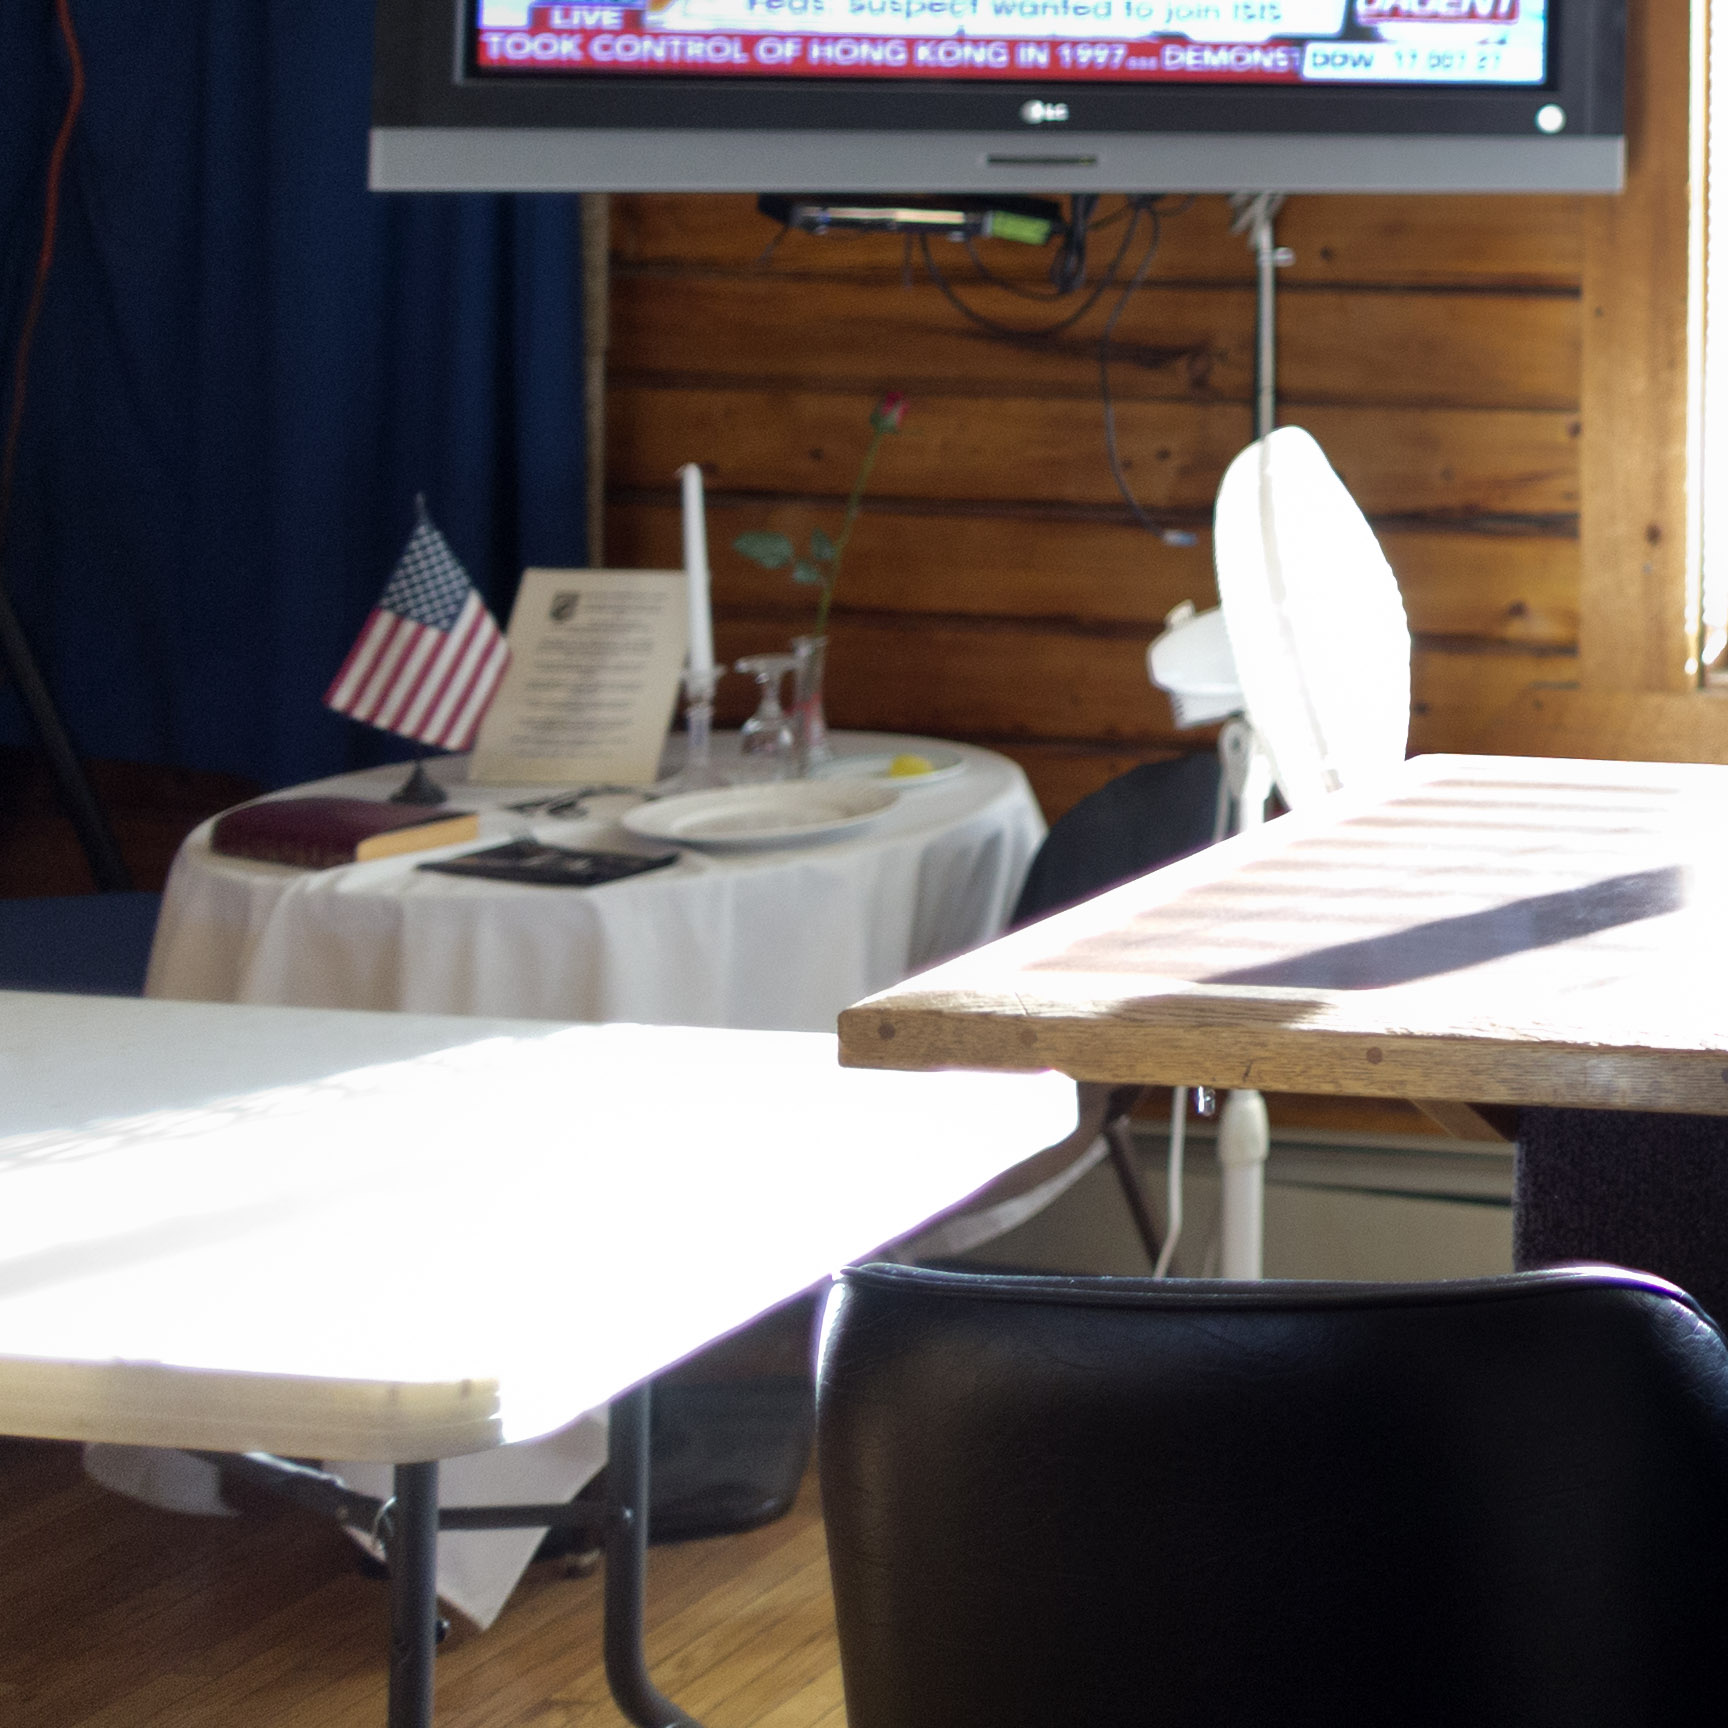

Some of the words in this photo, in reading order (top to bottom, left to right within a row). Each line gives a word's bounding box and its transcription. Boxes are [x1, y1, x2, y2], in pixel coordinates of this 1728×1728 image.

[553, 5, 623, 29] LIVE
[1124, 0, 1154, 20] to
[1164, 3, 1220, 24] join
[485, 34, 584, 61] TOOK
[588, 34, 747, 64] CONTROL
[754, 36, 801, 65] OF
[808, 39, 907, 68] HONG
[912, 41, 1010, 69] KONG
[1015, 43, 1048, 69] IN
[1311, 50, 1374, 69] DOW
